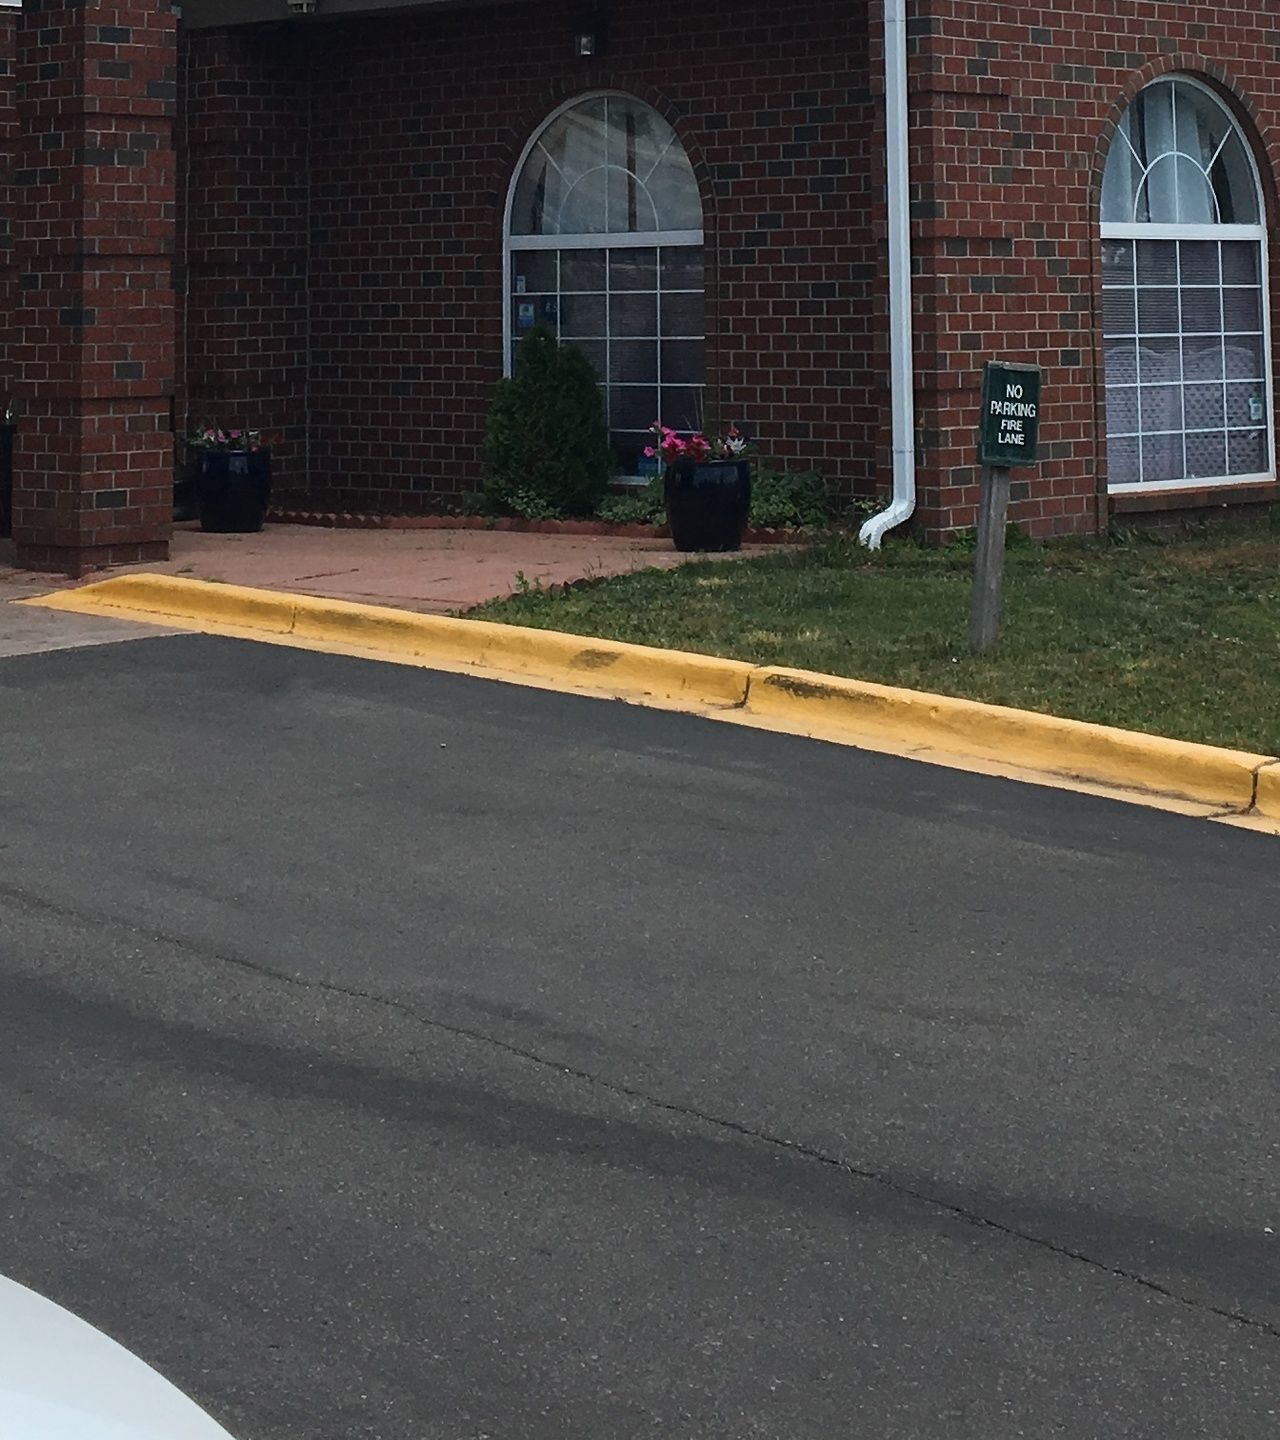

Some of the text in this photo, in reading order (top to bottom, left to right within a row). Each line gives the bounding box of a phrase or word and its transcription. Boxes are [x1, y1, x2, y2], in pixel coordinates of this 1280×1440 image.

[1006, 384, 1023, 399] NO
[990, 401, 1036, 417] PARKING
[1001, 419, 1023, 431] FIRE
[998, 432, 1025, 445] LANE
